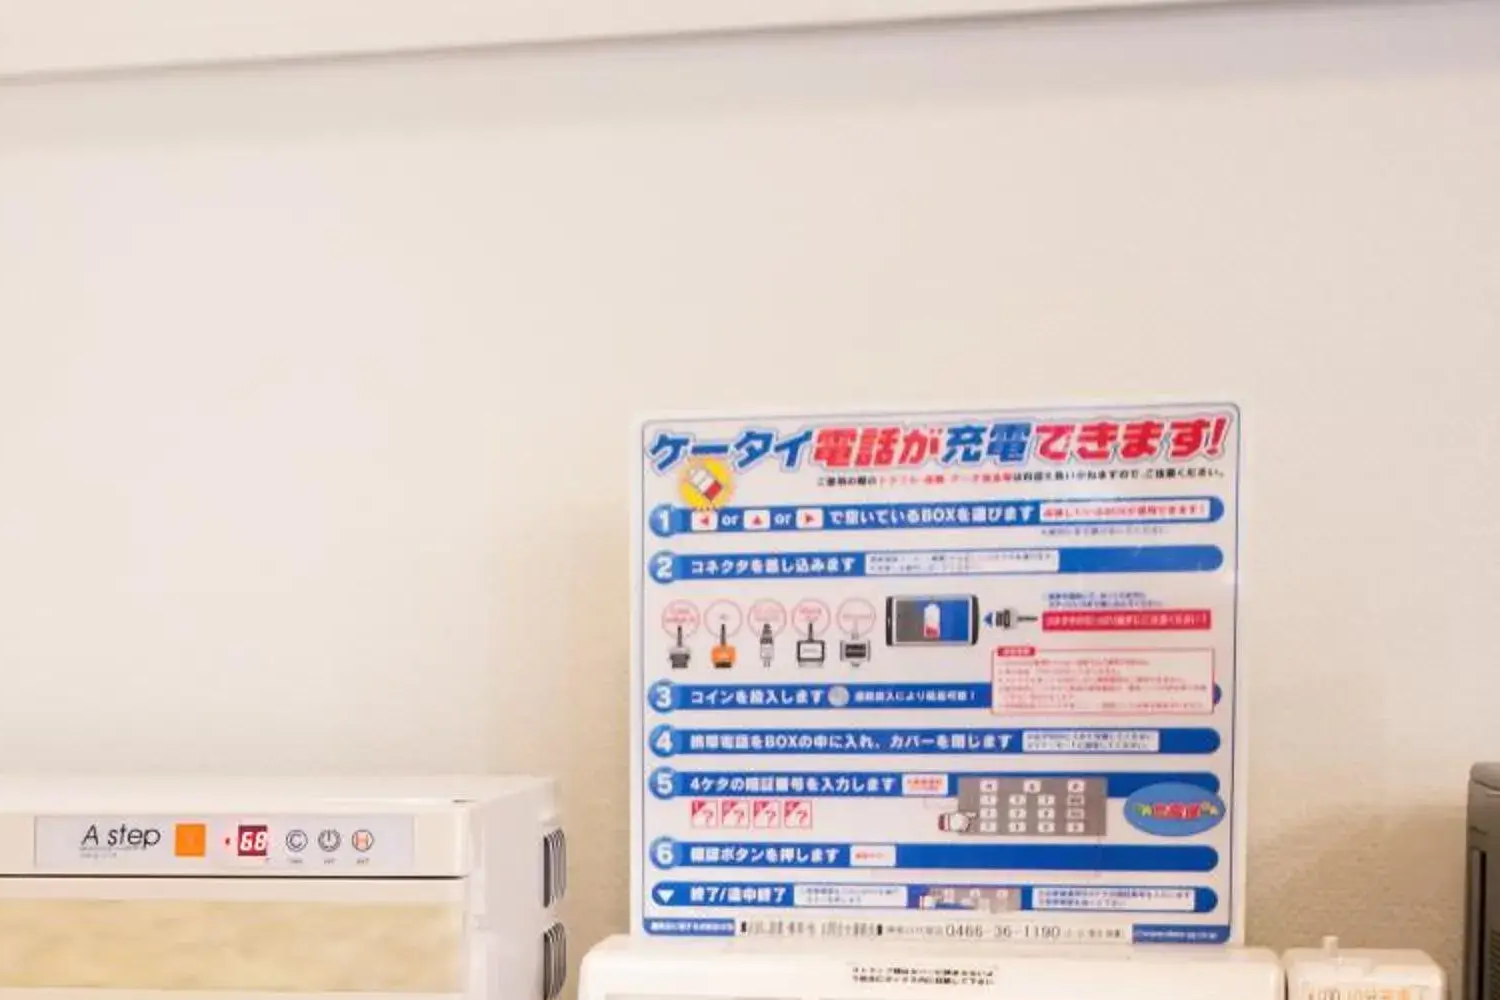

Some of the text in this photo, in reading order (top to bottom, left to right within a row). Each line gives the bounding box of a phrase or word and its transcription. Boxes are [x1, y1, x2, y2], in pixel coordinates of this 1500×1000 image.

[650, 417, 1229, 471] ケータイ電話が充電できます!
[659, 510, 670, 529] 1
[721, 513, 741, 526] or
[775, 512, 792, 526] or
[656, 557, 673, 578] 2
[658, 685, 672, 707] 3
[655, 732, 673, 750] 4
[657, 775, 673, 795] 5
[80, 823, 162, 849] A step
[658, 846, 673, 865] 6
